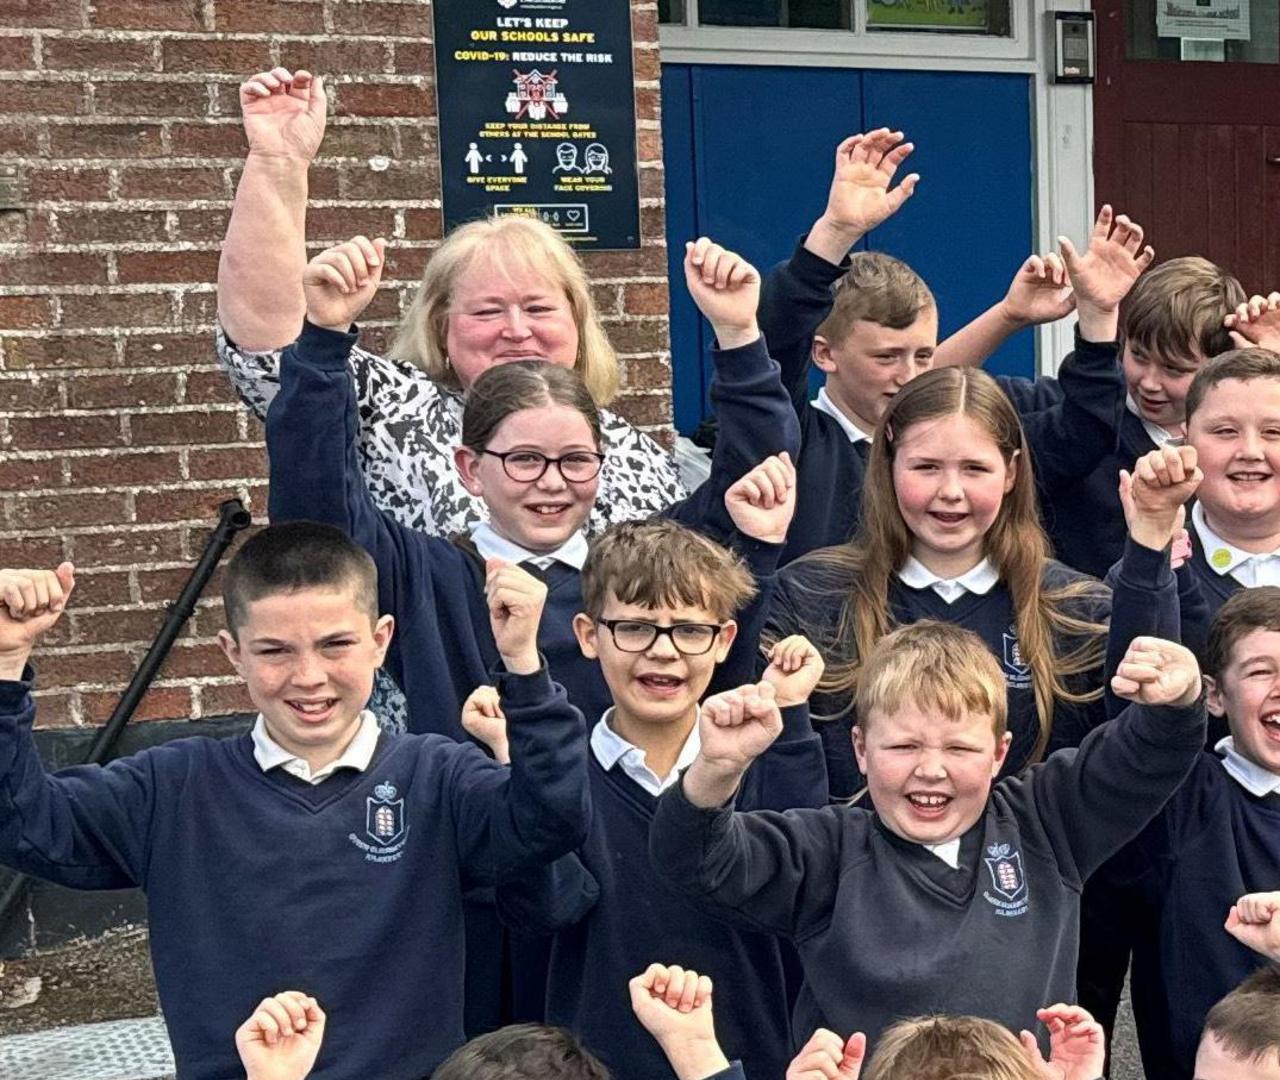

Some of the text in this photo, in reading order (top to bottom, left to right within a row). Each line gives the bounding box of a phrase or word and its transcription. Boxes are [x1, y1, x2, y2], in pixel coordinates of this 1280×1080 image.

[496, 17, 569, 28] LET'S KEEP
[470, 30, 596, 43] OUR SCHOOLS SAFE
[454, 51, 613, 63] COVID-19: REDUCE THE RISK
[569, 123, 590, 131] FROM
[572, 131, 597, 139] GATES
